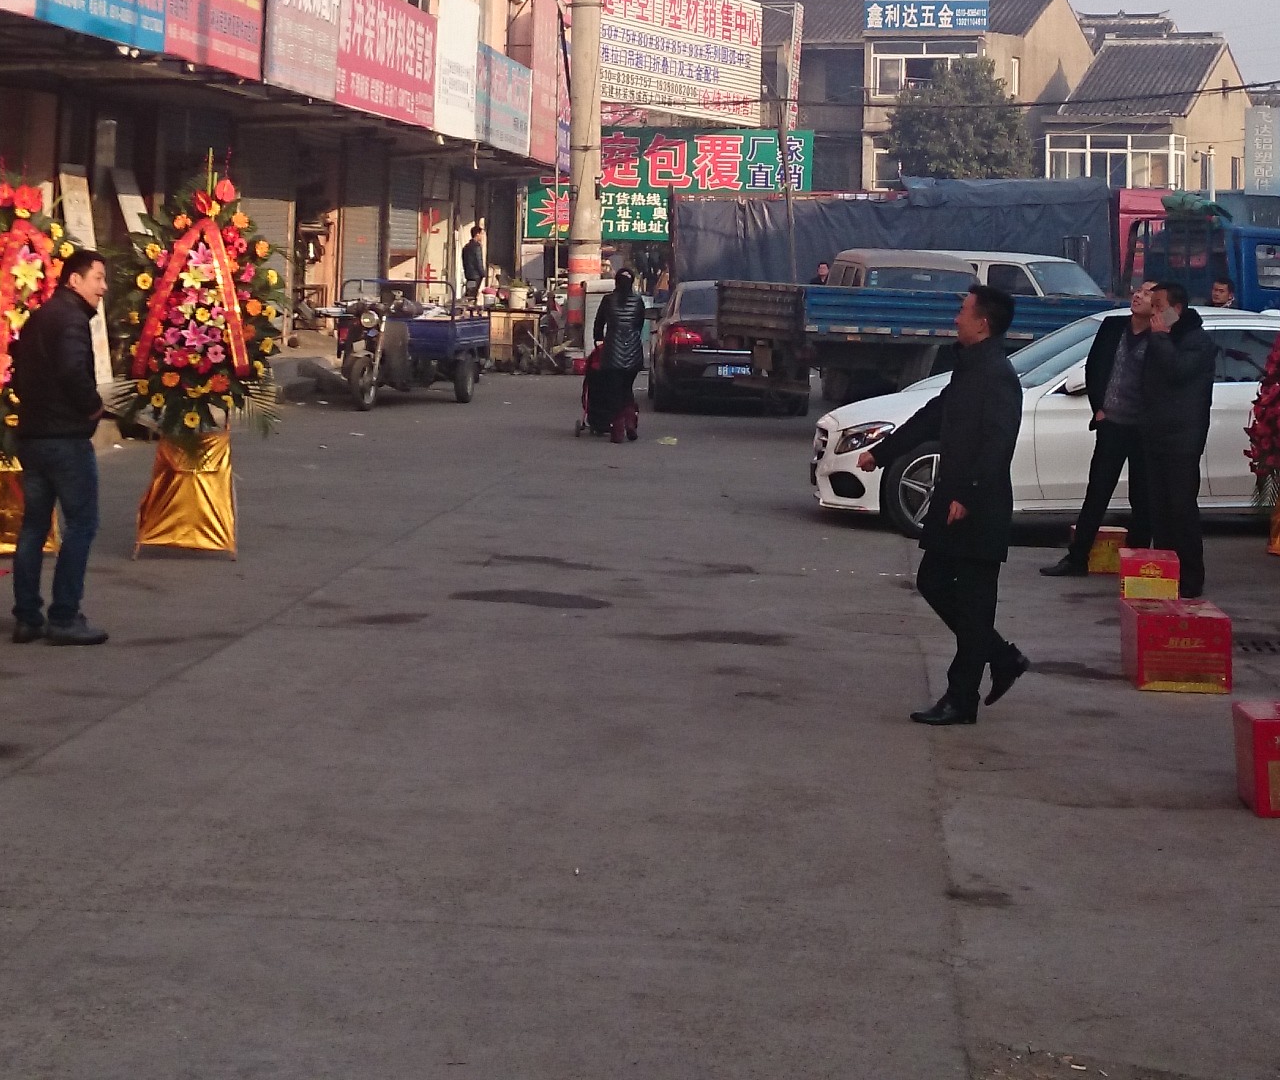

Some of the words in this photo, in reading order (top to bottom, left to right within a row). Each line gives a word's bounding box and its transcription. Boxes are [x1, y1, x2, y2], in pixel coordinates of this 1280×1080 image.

[867, 3, 954, 28] 鑫利达五金
